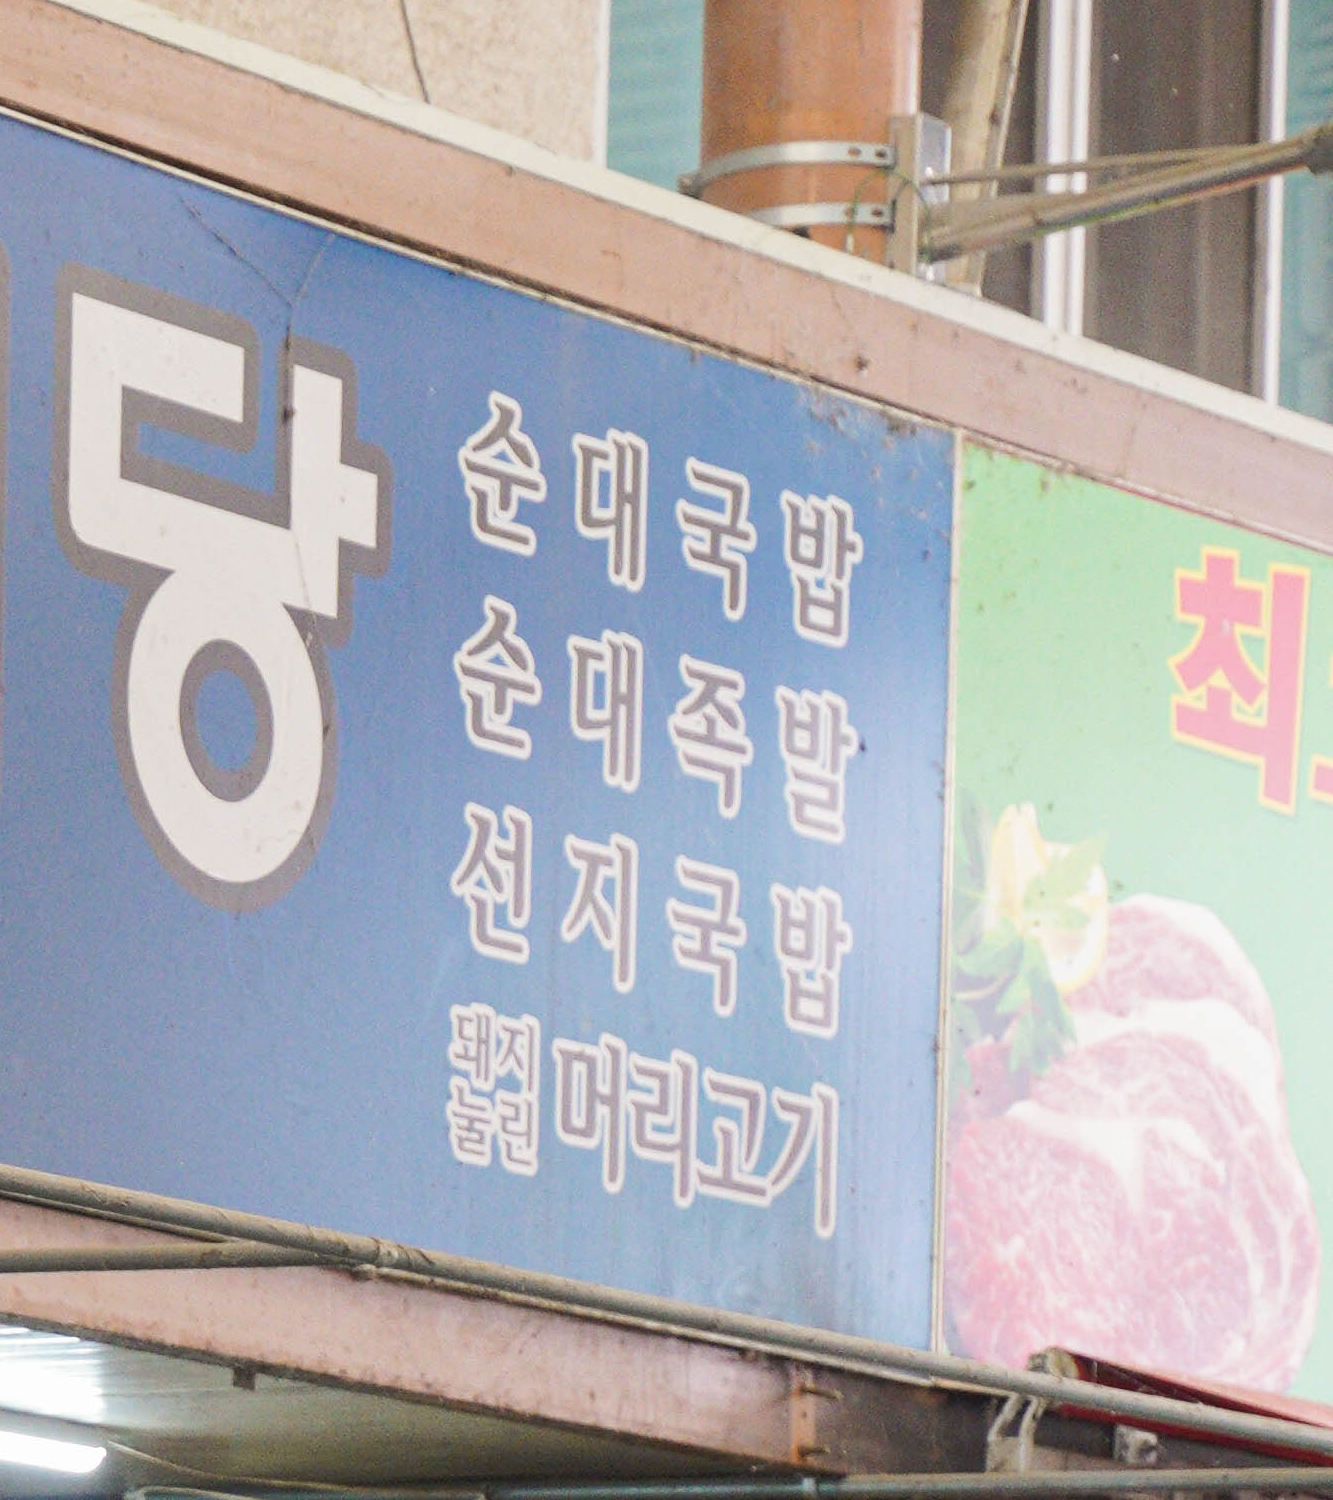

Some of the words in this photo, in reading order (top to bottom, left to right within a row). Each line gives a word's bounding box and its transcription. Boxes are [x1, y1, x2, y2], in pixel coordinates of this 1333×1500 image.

[459, 390, 863, 648] 순대국밥
[453, 595, 857, 846] 순대족발
[1168, 544, 1333, 817] 최
[452, 803, 853, 1039] 선지국밥
[448, 1002, 541, 1095] 돼지
[552, 1032, 839, 1238] 머리고기
